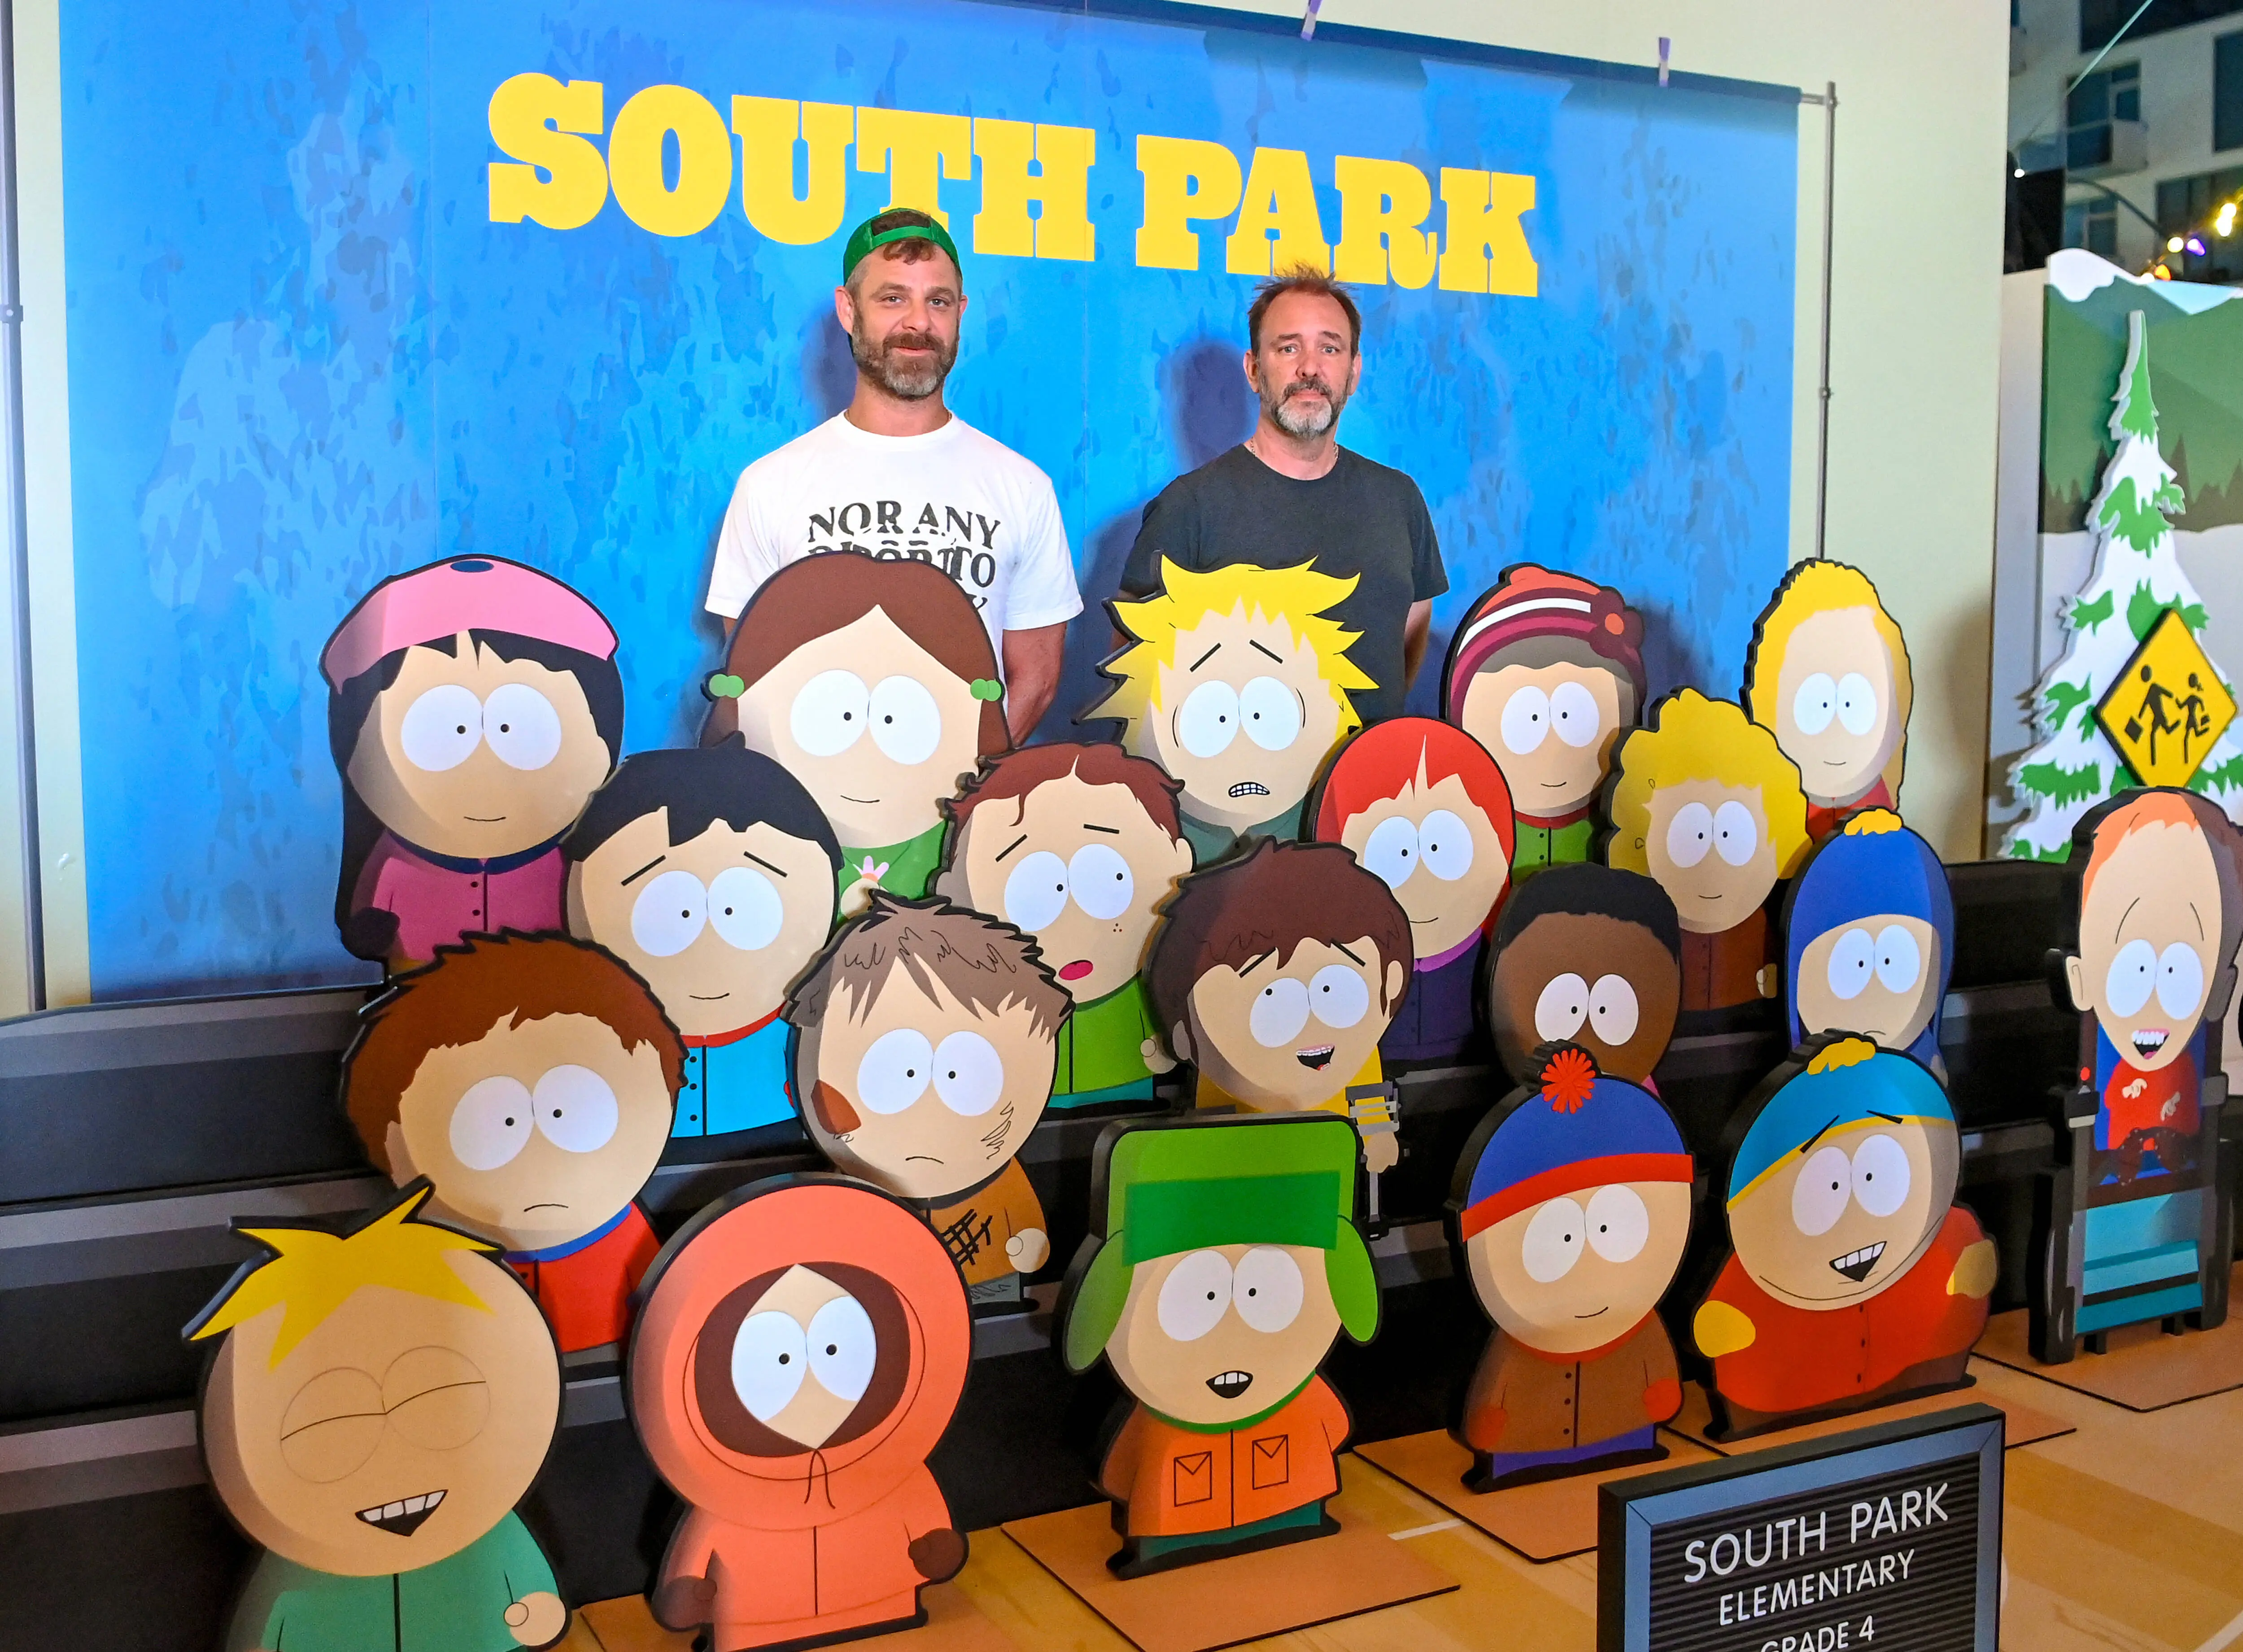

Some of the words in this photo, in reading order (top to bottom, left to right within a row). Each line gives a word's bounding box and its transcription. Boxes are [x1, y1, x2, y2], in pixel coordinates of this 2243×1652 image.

[488, 72, 1096, 262] SOUTH
[1136, 134, 1539, 298] PARK
[807, 500, 904, 543] NOR
[912, 502, 1001, 550] ANY
[1684, 1510, 1826, 1583] SOUTH
[1850, 1482, 1949, 1544] PARK
[1719, 1548, 1915, 1626] ELEMENTARY
[1858, 1615, 1875, 1642] 4
